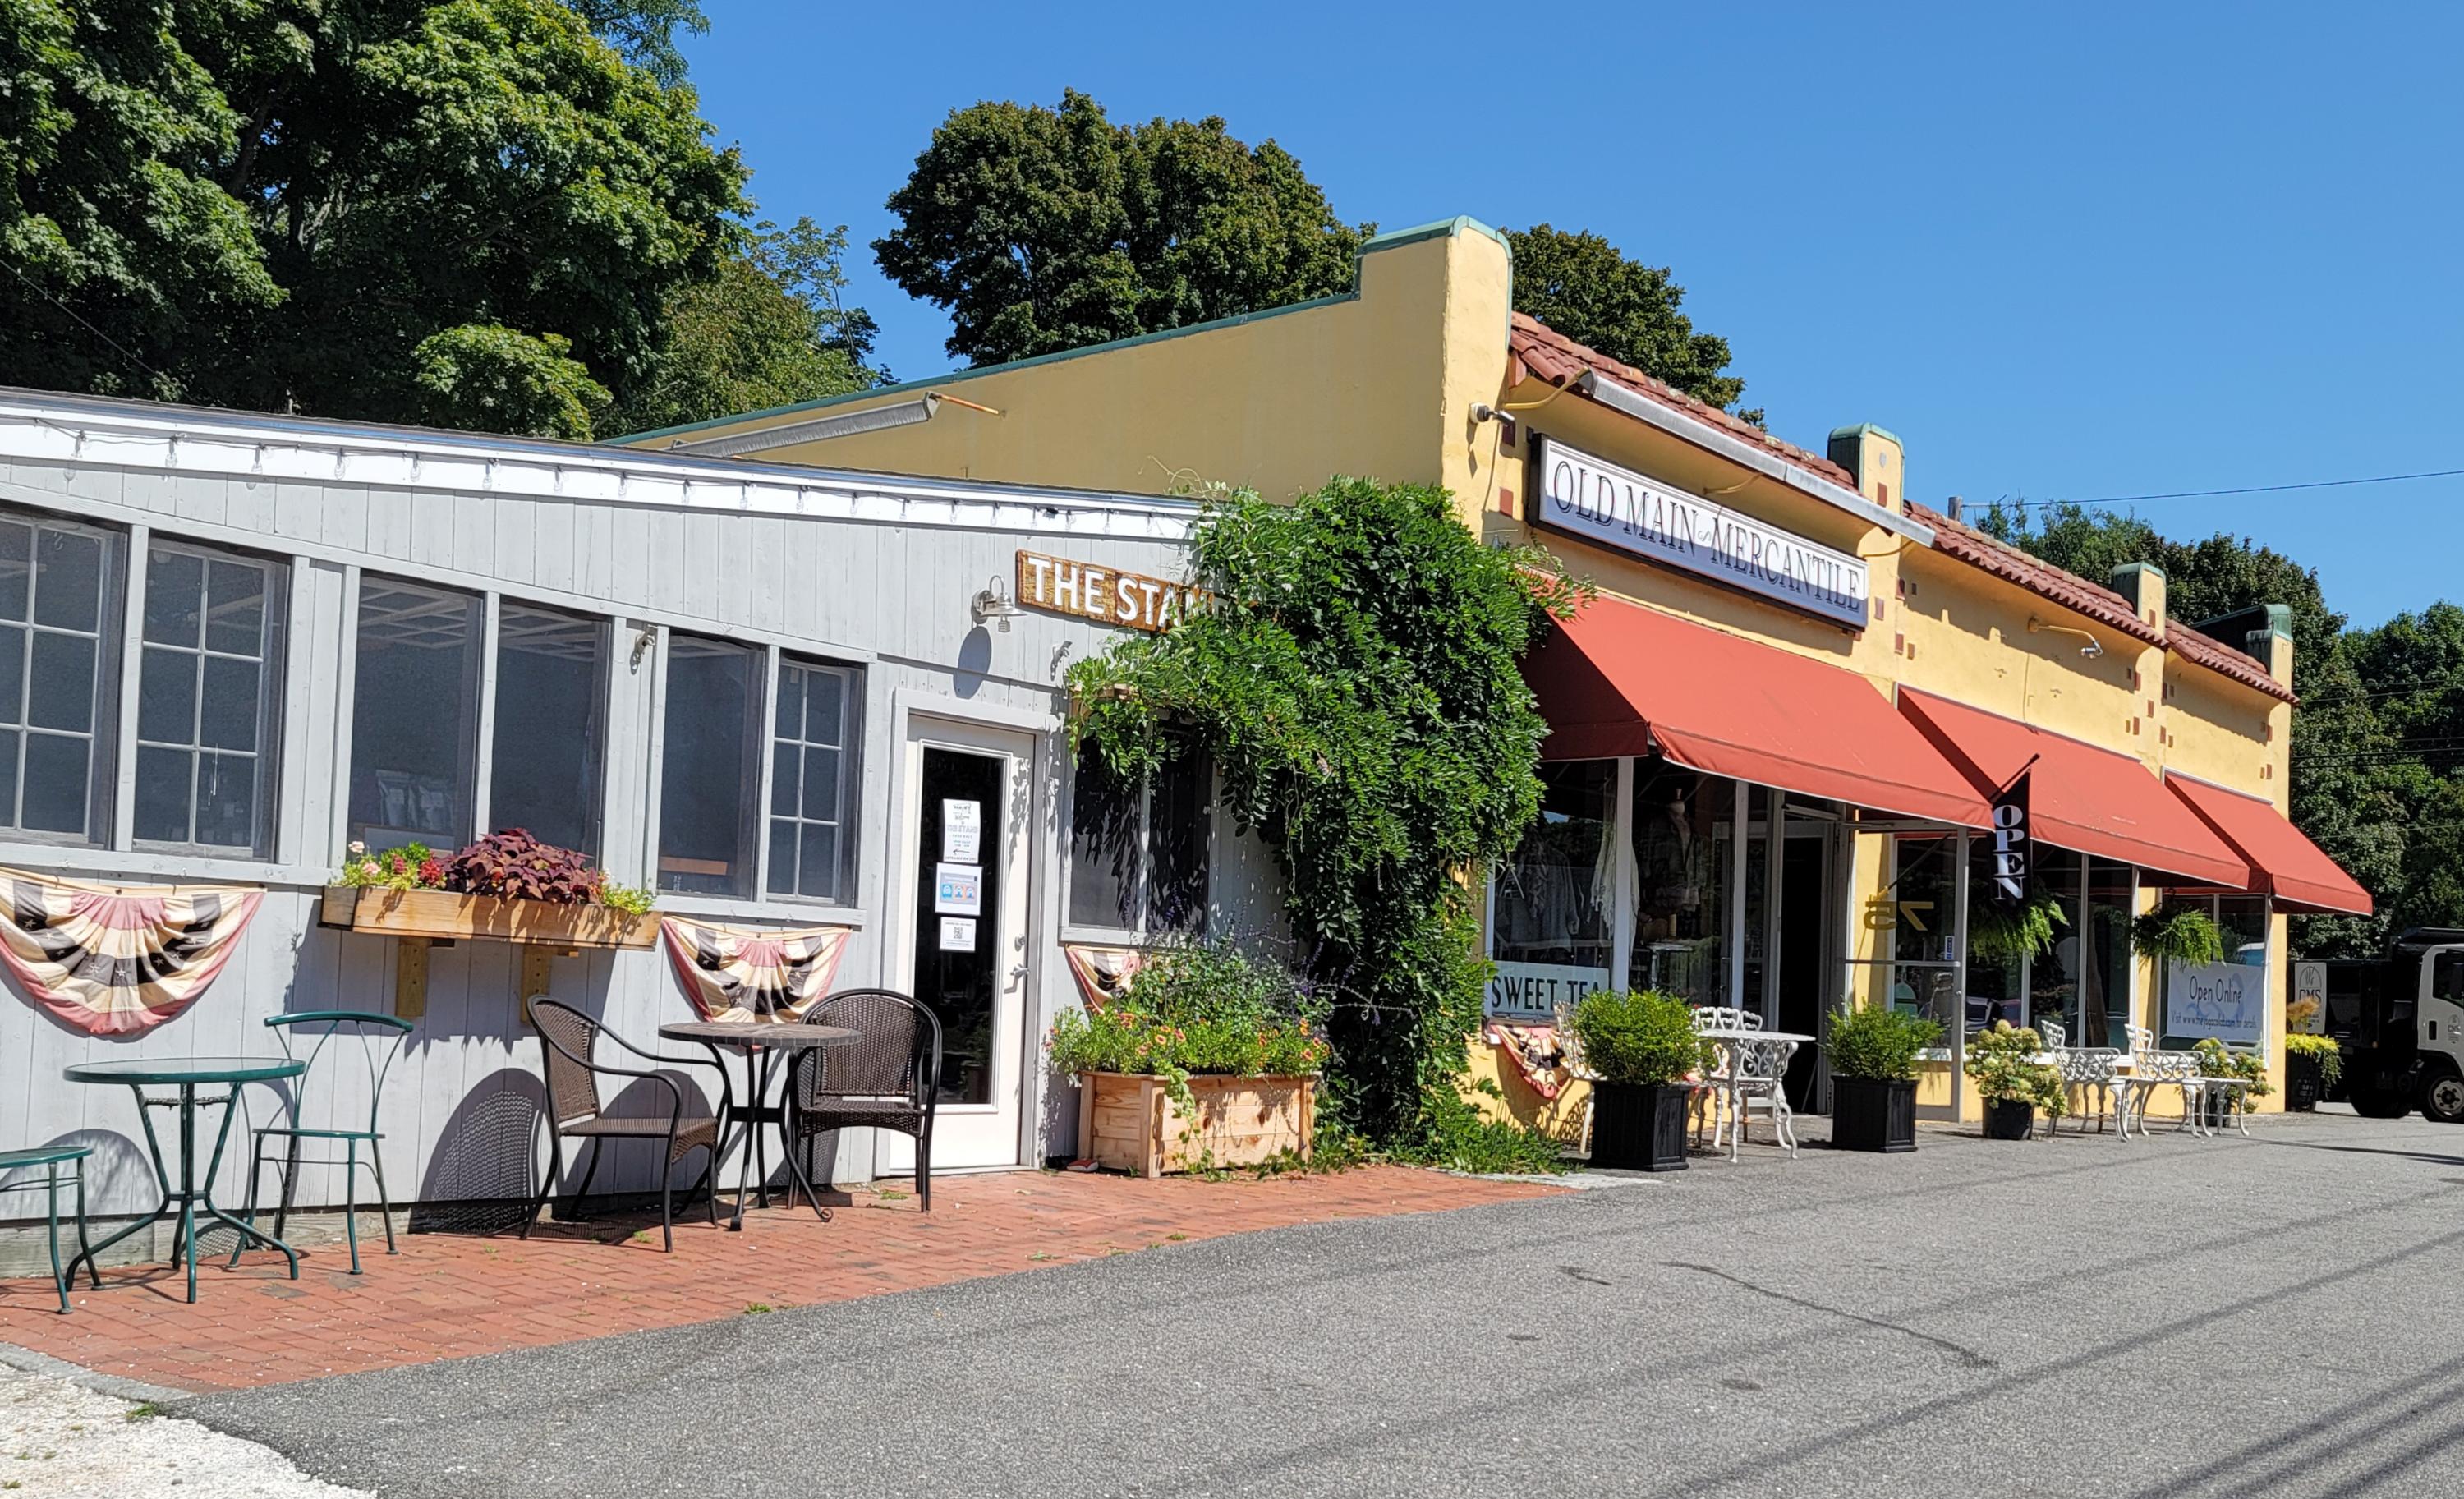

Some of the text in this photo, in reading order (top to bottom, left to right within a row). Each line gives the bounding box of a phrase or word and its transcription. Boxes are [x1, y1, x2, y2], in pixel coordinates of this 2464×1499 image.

[1554, 460, 1861, 613] OLD MAIN MERCANTILE
[1028, 555, 1106, 614] THE
[1992, 804, 2027, 900] OPEN
[1492, 975, 1558, 1010] SWEET
[2189, 975, 2242, 1007] Open Online
